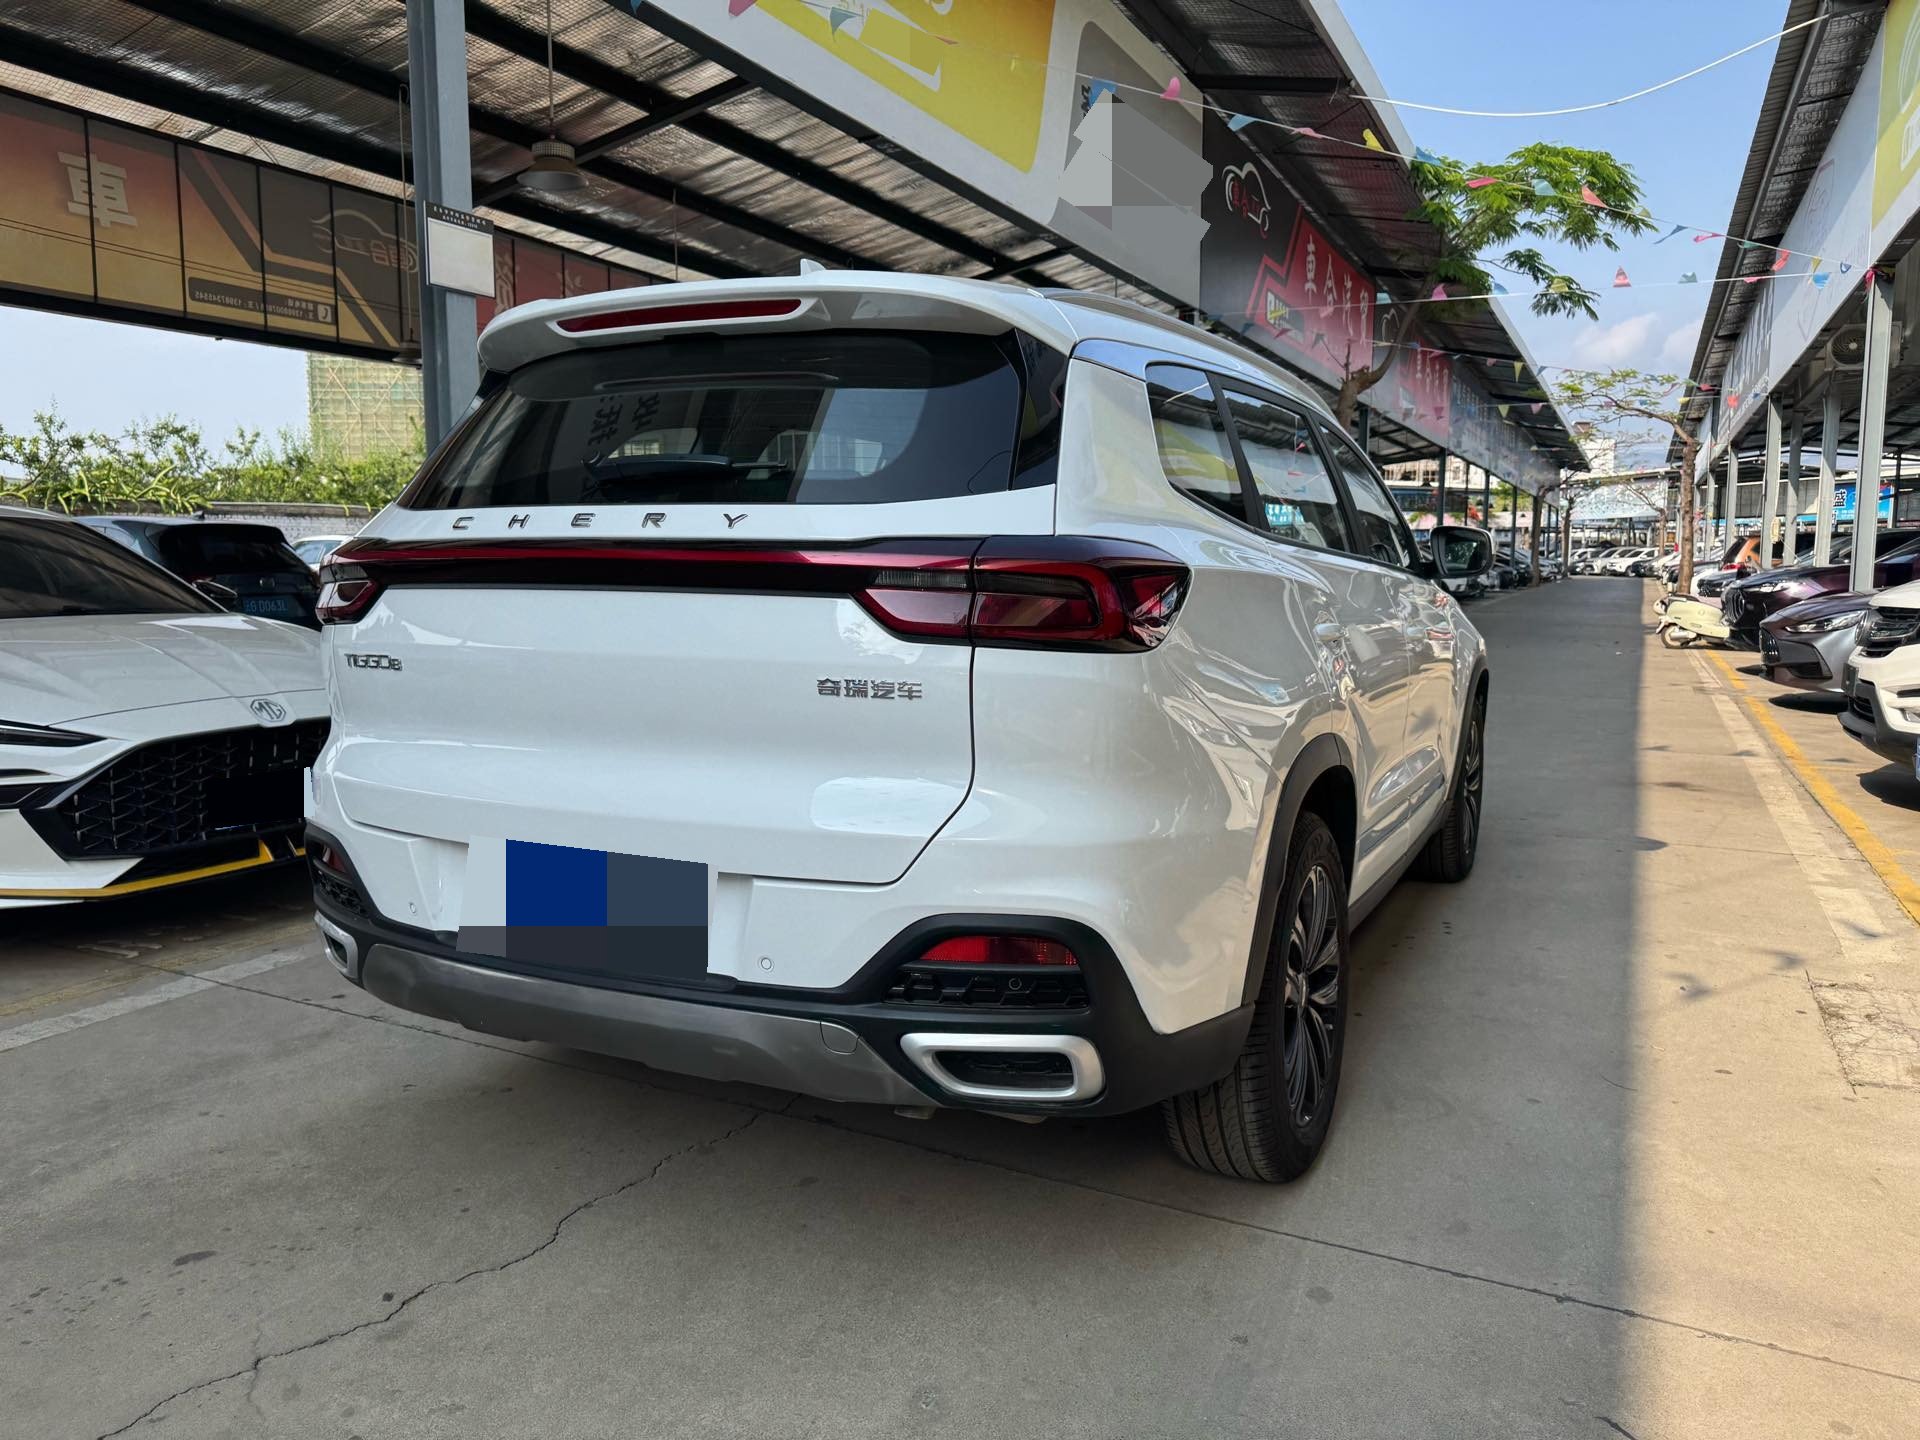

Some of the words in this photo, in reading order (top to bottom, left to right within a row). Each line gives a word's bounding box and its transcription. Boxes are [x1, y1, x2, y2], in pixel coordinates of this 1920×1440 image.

[452, 512, 749, 530] CHERY
[816, 678, 922, 701] 奇瑞汽车
[252, 699, 285, 721] MG
